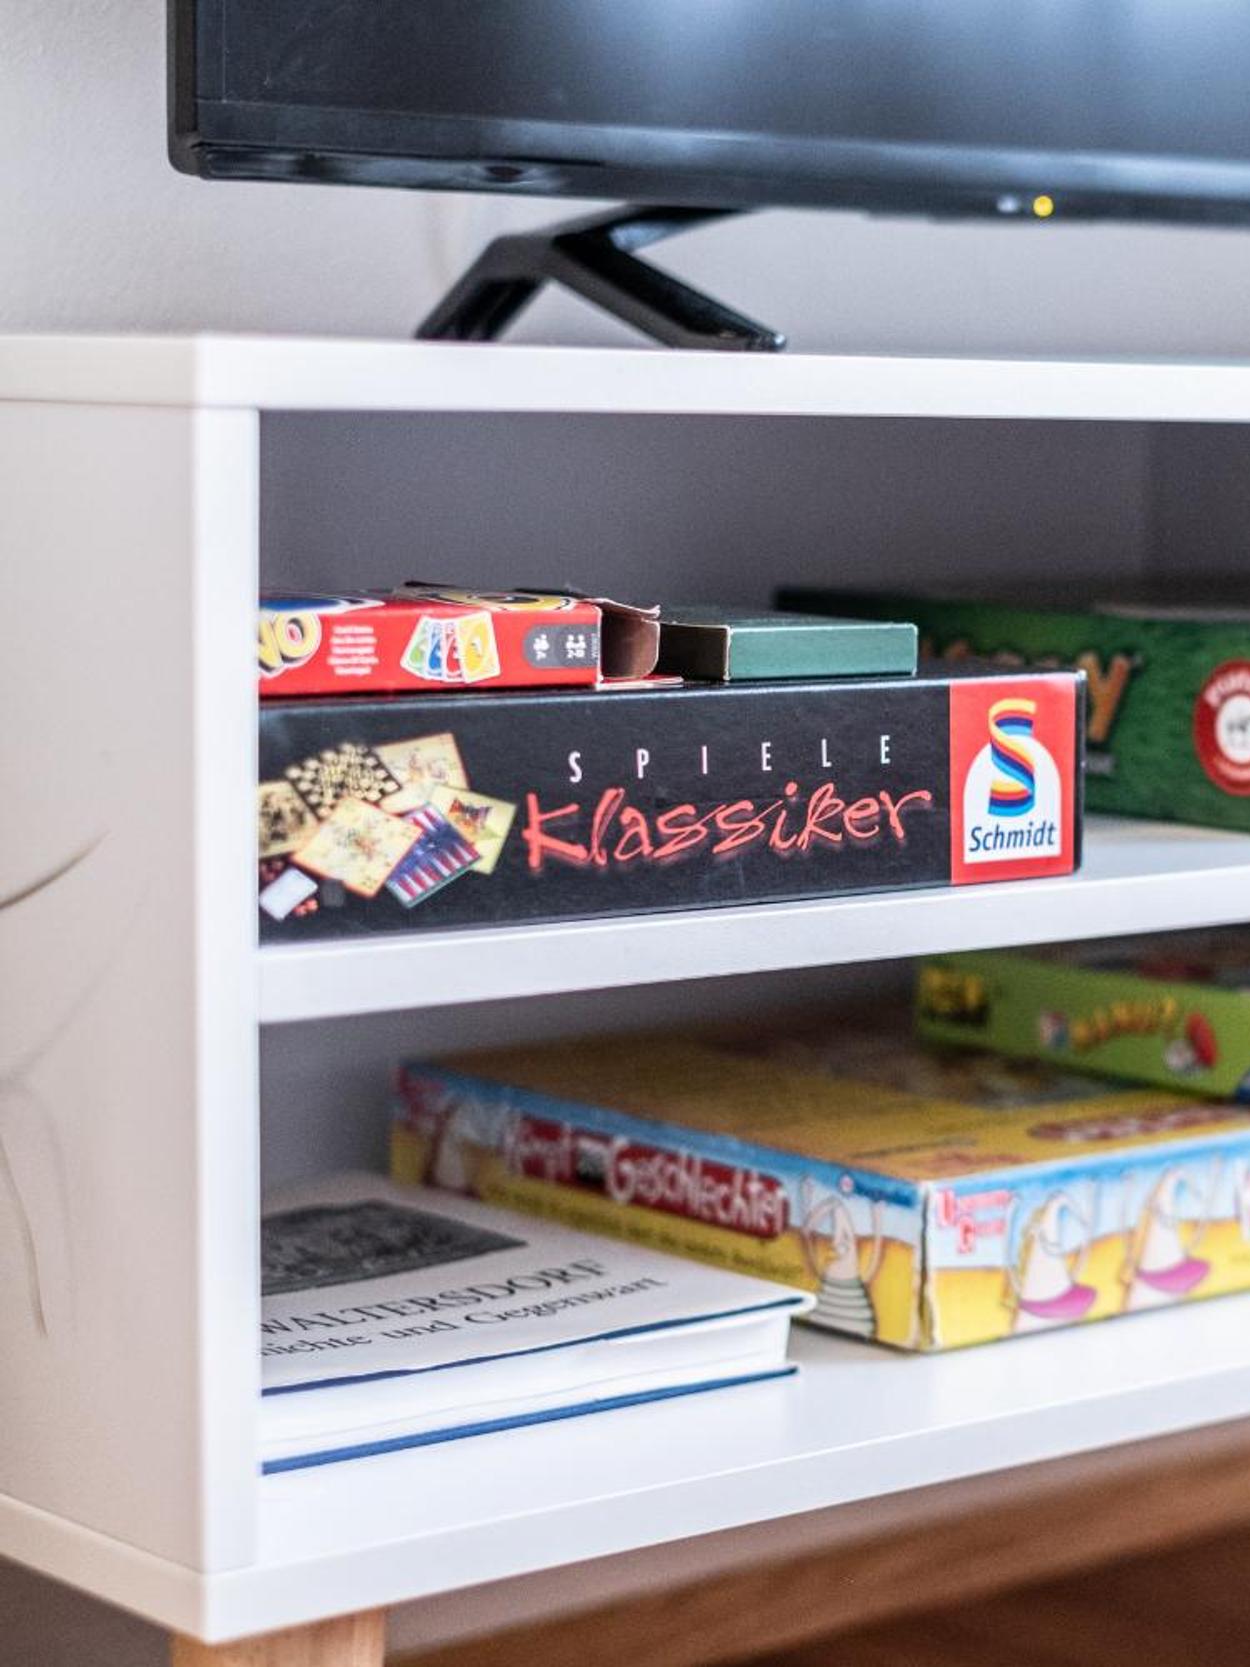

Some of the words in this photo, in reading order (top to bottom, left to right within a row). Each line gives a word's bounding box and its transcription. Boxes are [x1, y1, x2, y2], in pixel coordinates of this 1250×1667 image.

[568, 734, 891, 784] SPIELE
[522, 780, 932, 872] Klassiker
[969, 820, 1057, 852] Schmidt
[381, 1320, 461, 1340] und
[464, 1276, 668, 1324] Gegenwart
